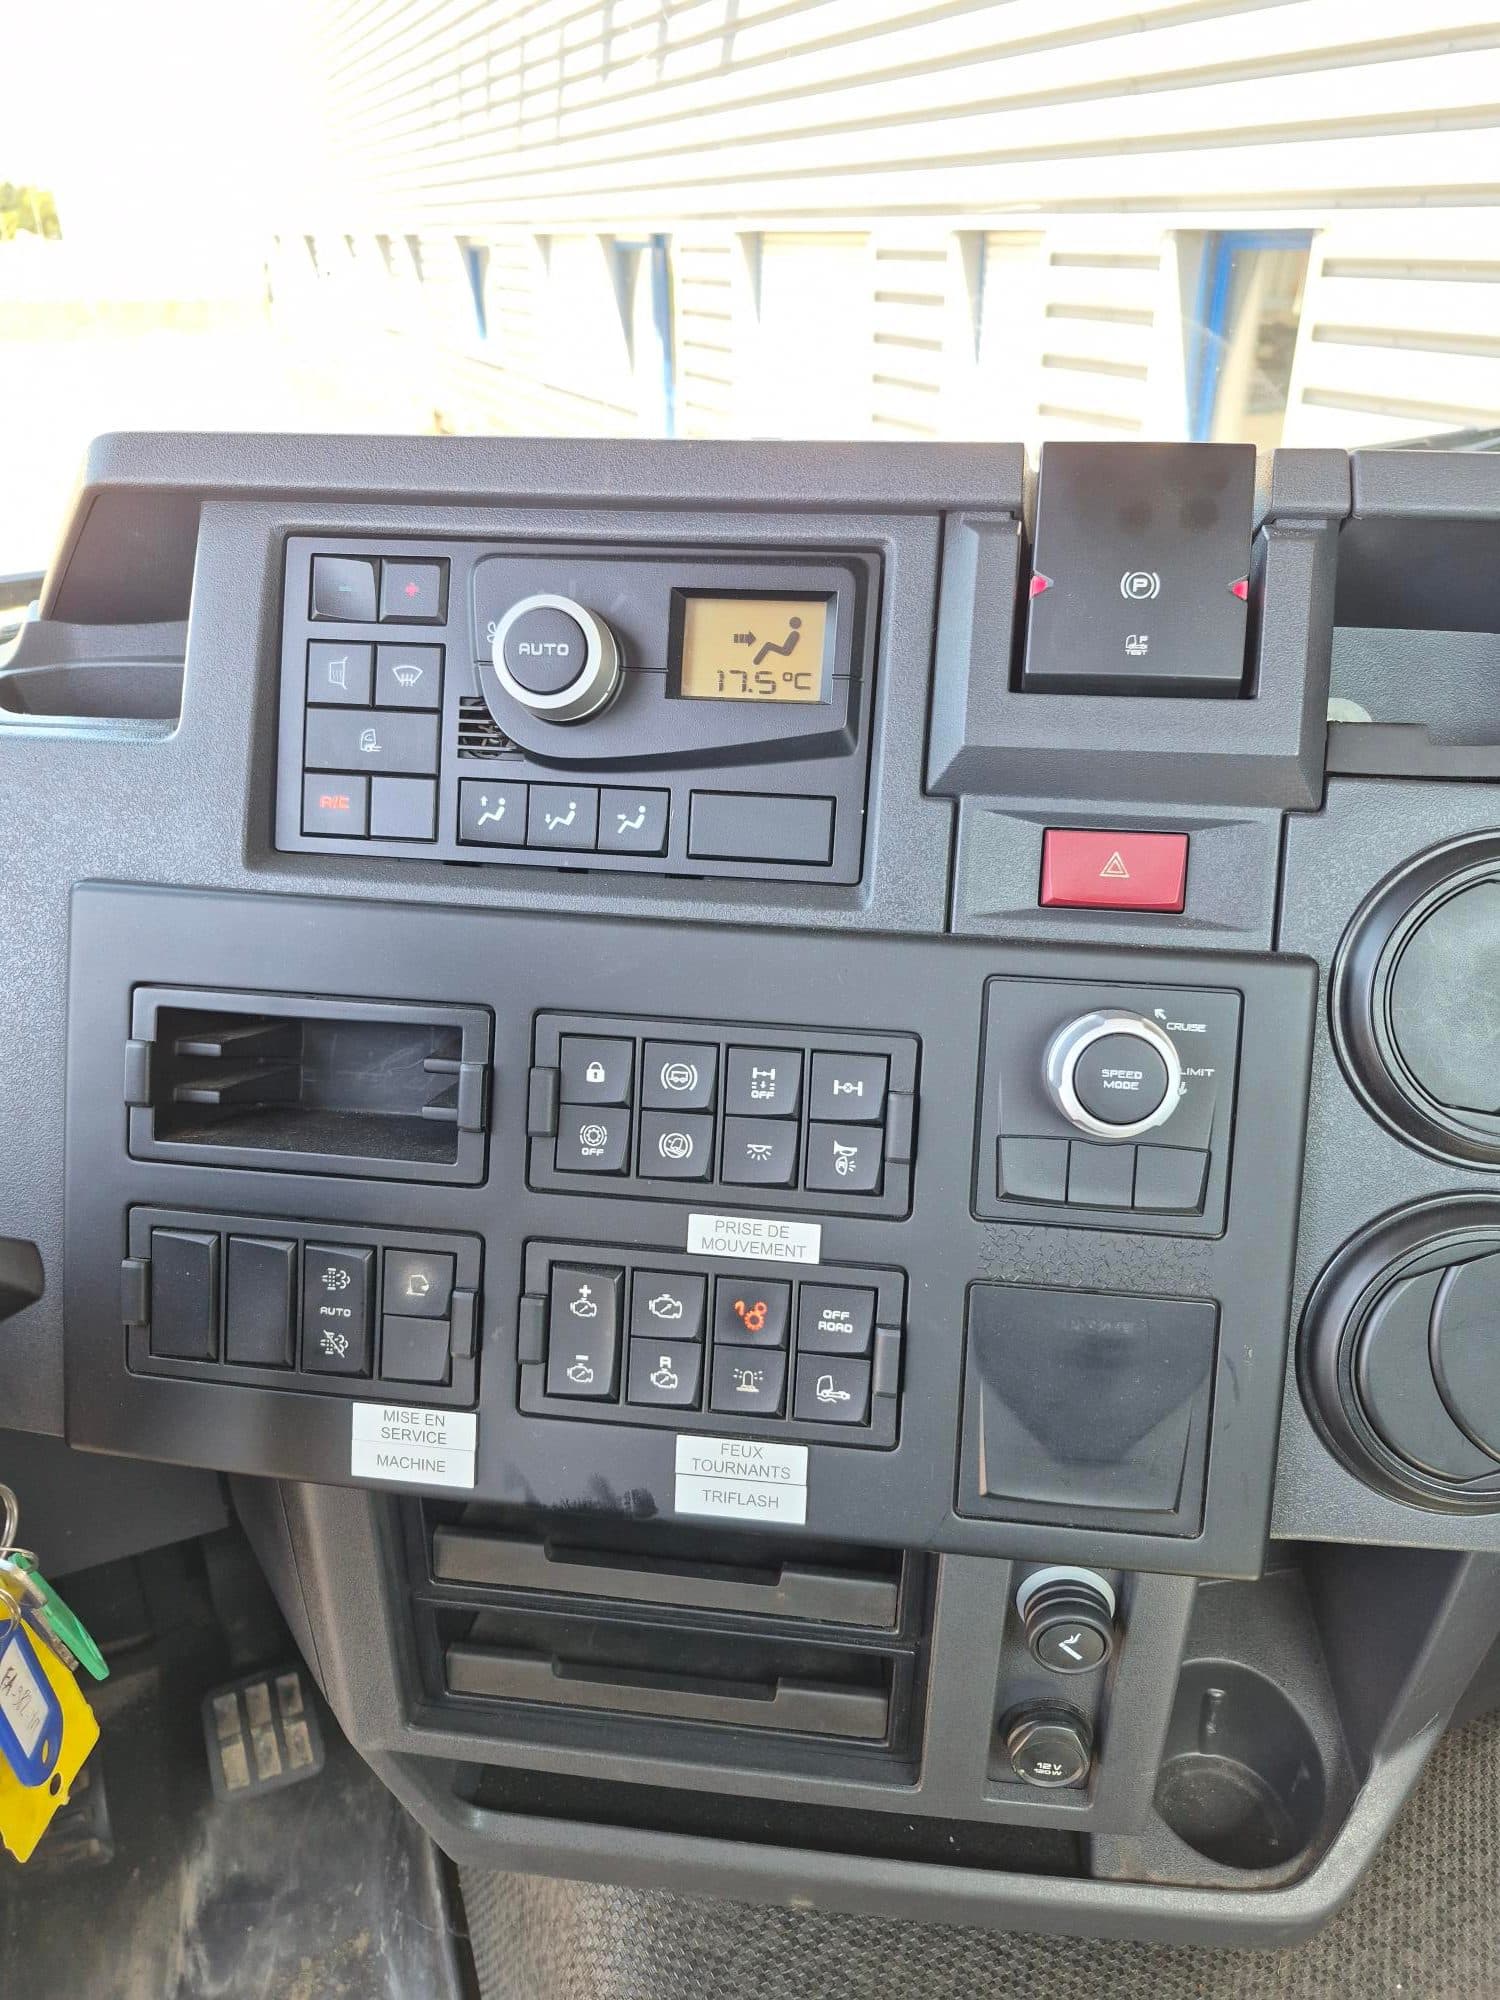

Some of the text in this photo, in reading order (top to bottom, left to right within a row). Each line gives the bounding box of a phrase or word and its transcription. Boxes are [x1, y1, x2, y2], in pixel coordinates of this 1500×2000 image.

[518, 642, 570, 656] AUTO
[1166, 1022, 1208, 1033] CRUISE
[1101, 1068, 1143, 1080] SPEED
[1103, 1080, 1140, 1091] MODE
[750, 1089, 775, 1100] OFF
[581, 1147, 605, 1157] OFF
[715, 1220, 790, 1239] PRISE DE
[701, 1236, 807, 1258] MOUVEMENT
[320, 1306, 352, 1318] AUTO
[822, 1309, 850, 1321] OFF
[818, 1320, 853, 1334] ROAD
[383, 1409, 446, 1427] MISE EN
[380, 1426, 448, 1445] SERVICE
[720, 1442, 765, 1460] FEUX
[376, 1454, 447, 1473] MACHINE
[692, 1457, 792, 1480] TOURNANTS
[701, 1489, 780, 1509] TRIFLASH
